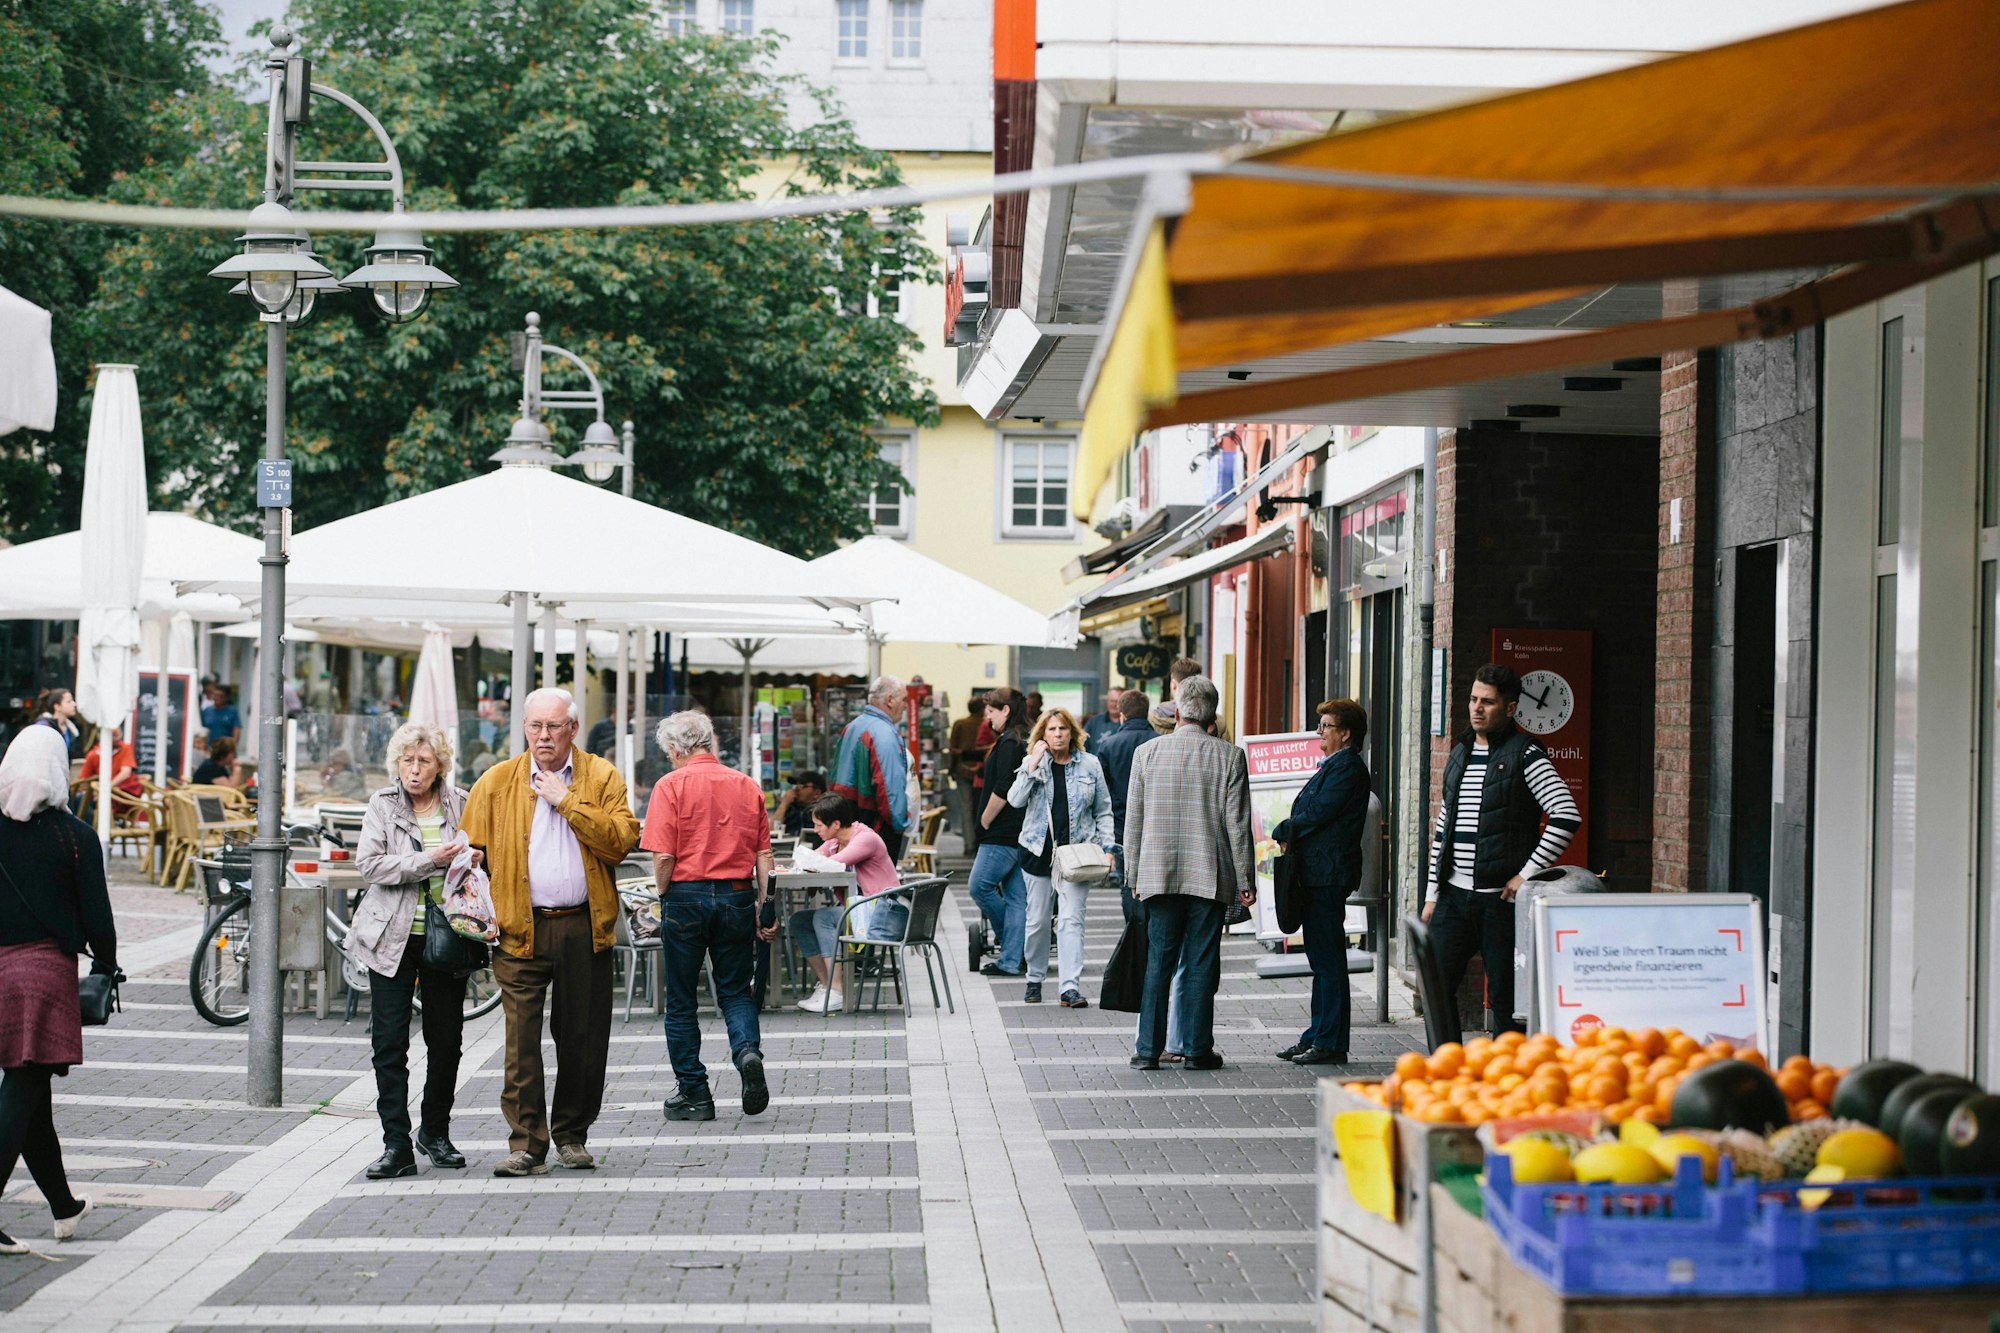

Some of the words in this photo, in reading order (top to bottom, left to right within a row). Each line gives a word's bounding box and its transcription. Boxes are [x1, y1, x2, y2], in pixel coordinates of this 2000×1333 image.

[266, 466, 274, 476] S
[1514, 652, 1530, 660] Köln
[1537, 675, 1545, 683] 12
[1562, 699, 1567, 707] 3
[1550, 719, 1555, 727] 5
[1272, 741, 1309, 755] unserer
[1255, 756, 1325, 772] WERBUN
[1572, 946, 1600, 957] Weil
[1602, 946, 1620, 957] Sie
[1622, 945, 1655, 957] Ihren
[1656, 945, 1696, 957] Traum
[1697, 945, 1729, 957] nicht
[1573, 961, 1632, 975] irgendwie
